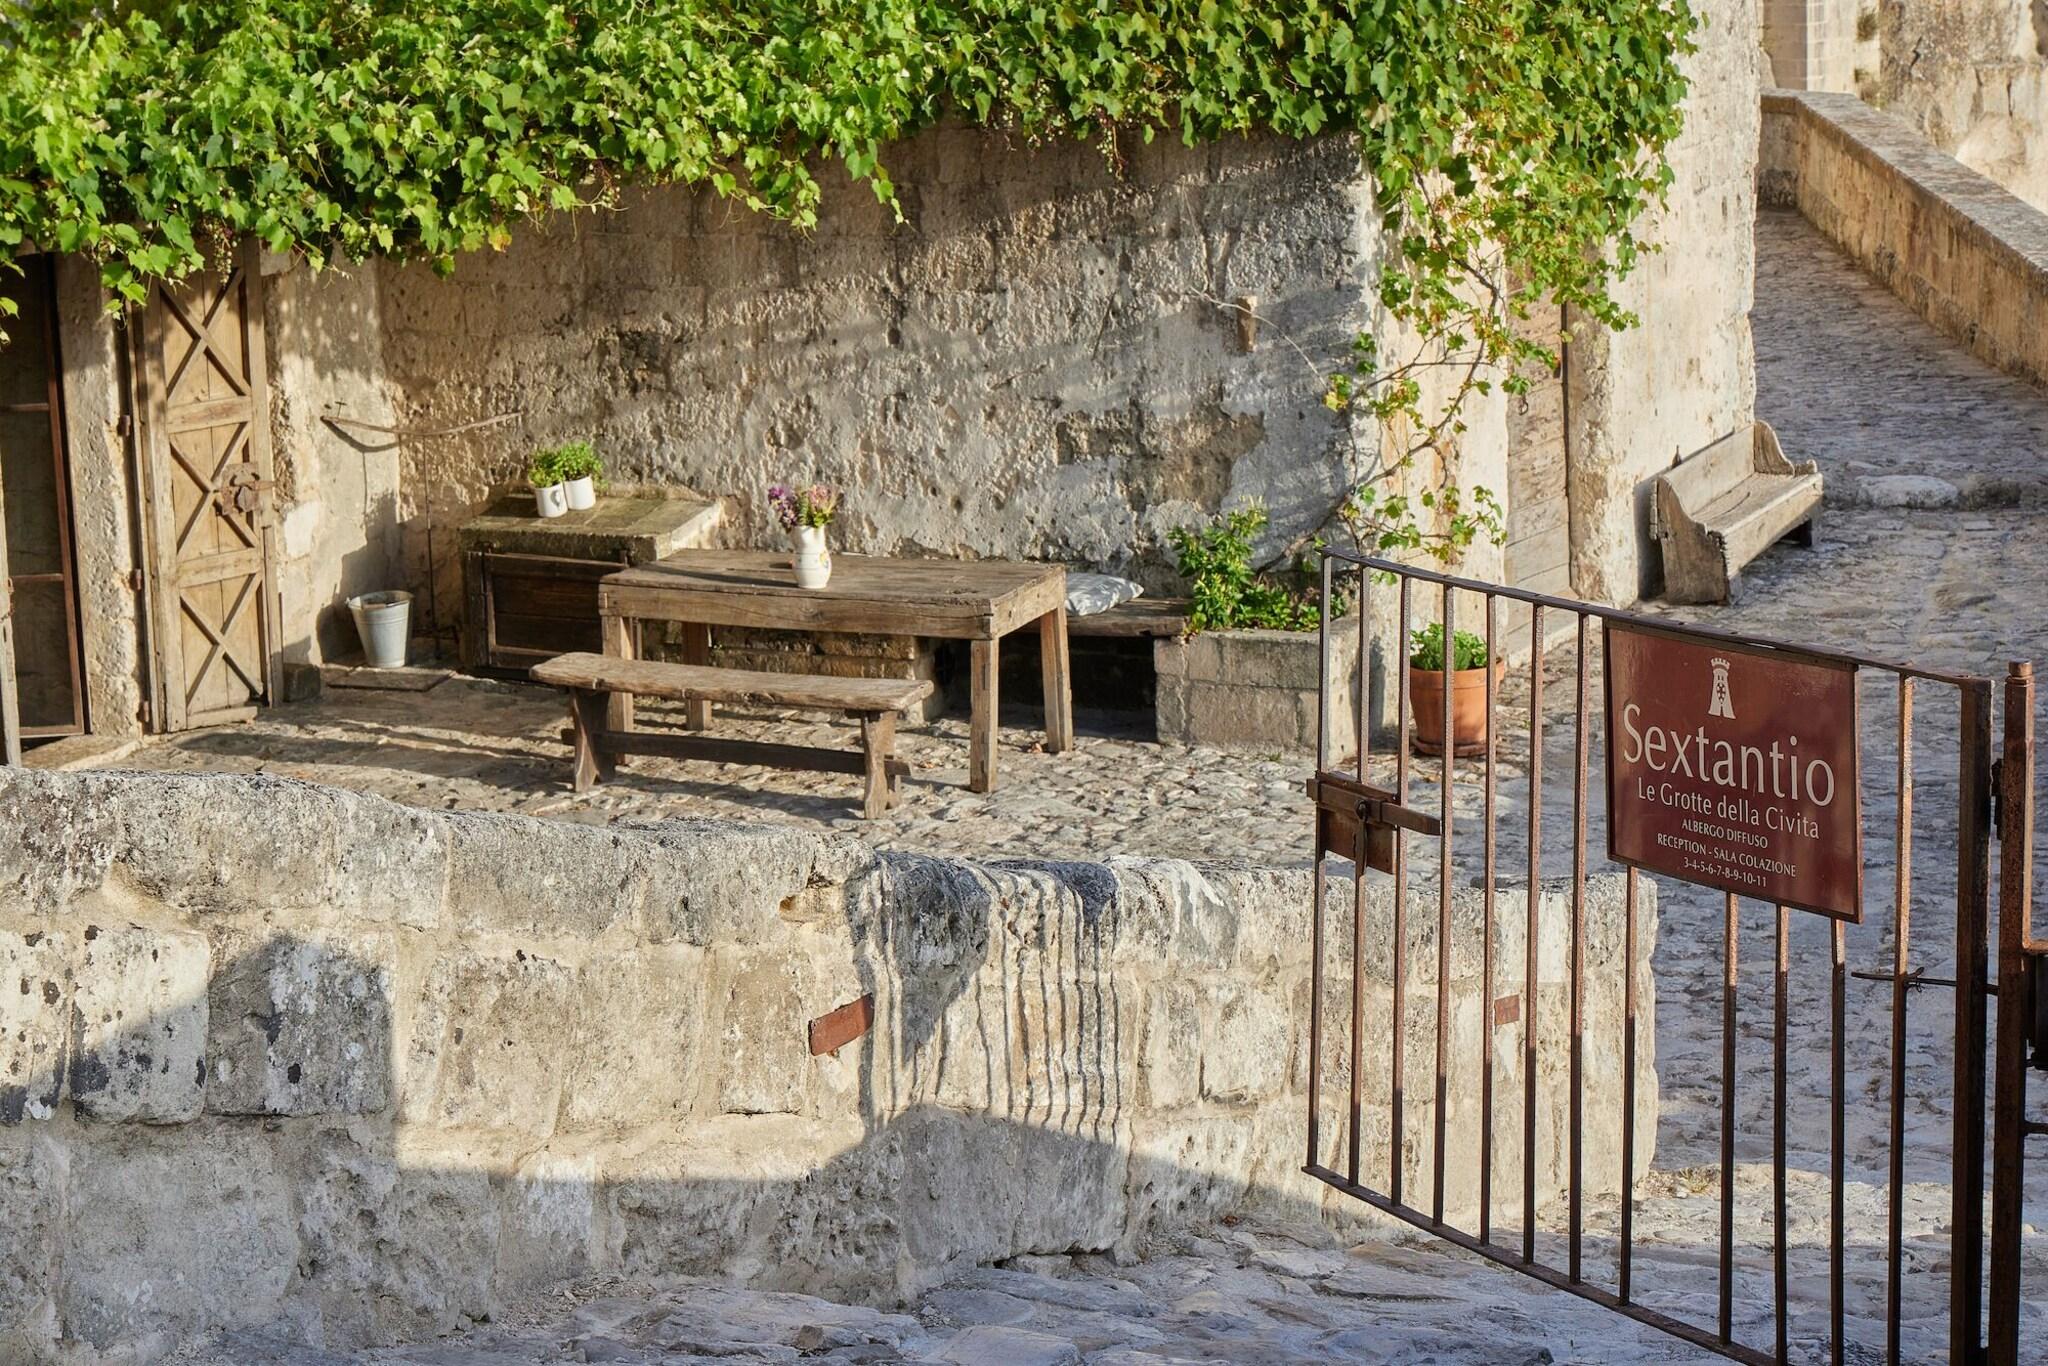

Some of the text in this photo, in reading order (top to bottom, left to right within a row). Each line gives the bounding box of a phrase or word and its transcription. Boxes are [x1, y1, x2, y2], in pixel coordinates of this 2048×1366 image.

[1623, 703, 1835, 807] Sextantio
[1638, 776, 1655, 802] Le
[1660, 782, 1712, 815] Grotte
[1717, 795, 1760, 826] della
[1657, 833, 1707, 856] RECEPTION
[1713, 846, 1738, 864] SALA
[1738, 853, 1796, 878] COLAZIONE
[1682, 818, 1768, 849] ALBERGO DIFFUSO
[1683, 857, 1767, 887] 3-4-5-6-7-8-9-10-11
